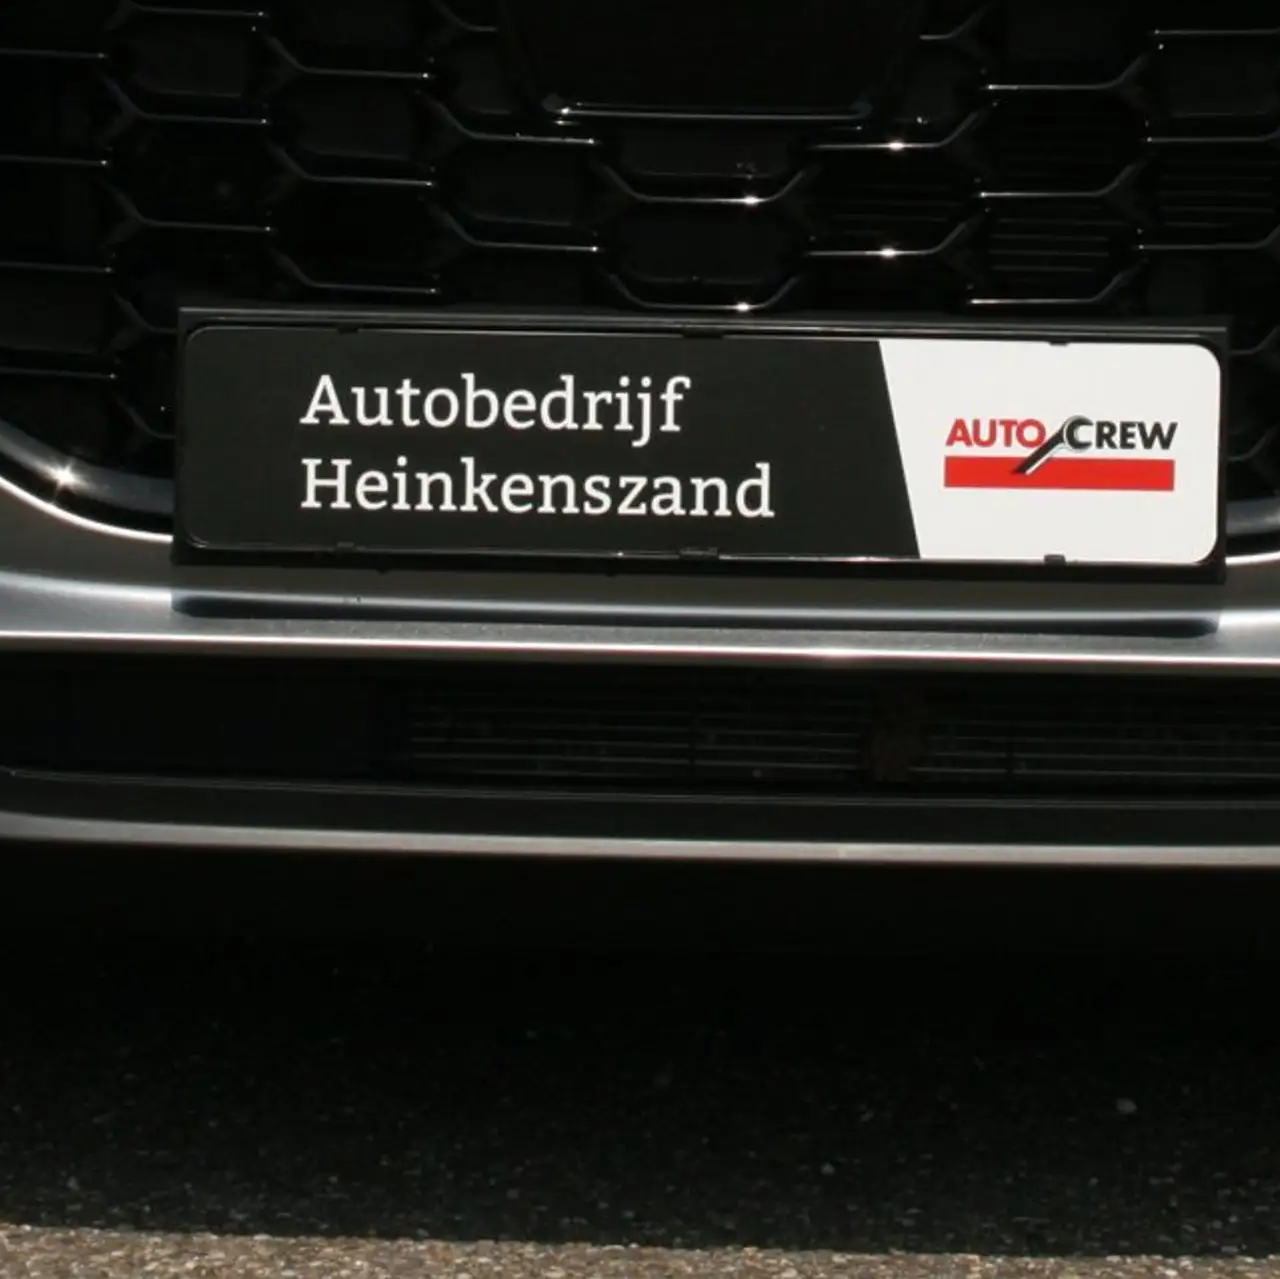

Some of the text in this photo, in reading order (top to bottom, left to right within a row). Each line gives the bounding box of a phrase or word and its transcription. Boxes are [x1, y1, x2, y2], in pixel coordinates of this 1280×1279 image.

[299, 372, 692, 448] Autobedrijf
[945, 417, 1178, 451] AUTO CREW
[300, 455, 775, 519] Heinkenszand
